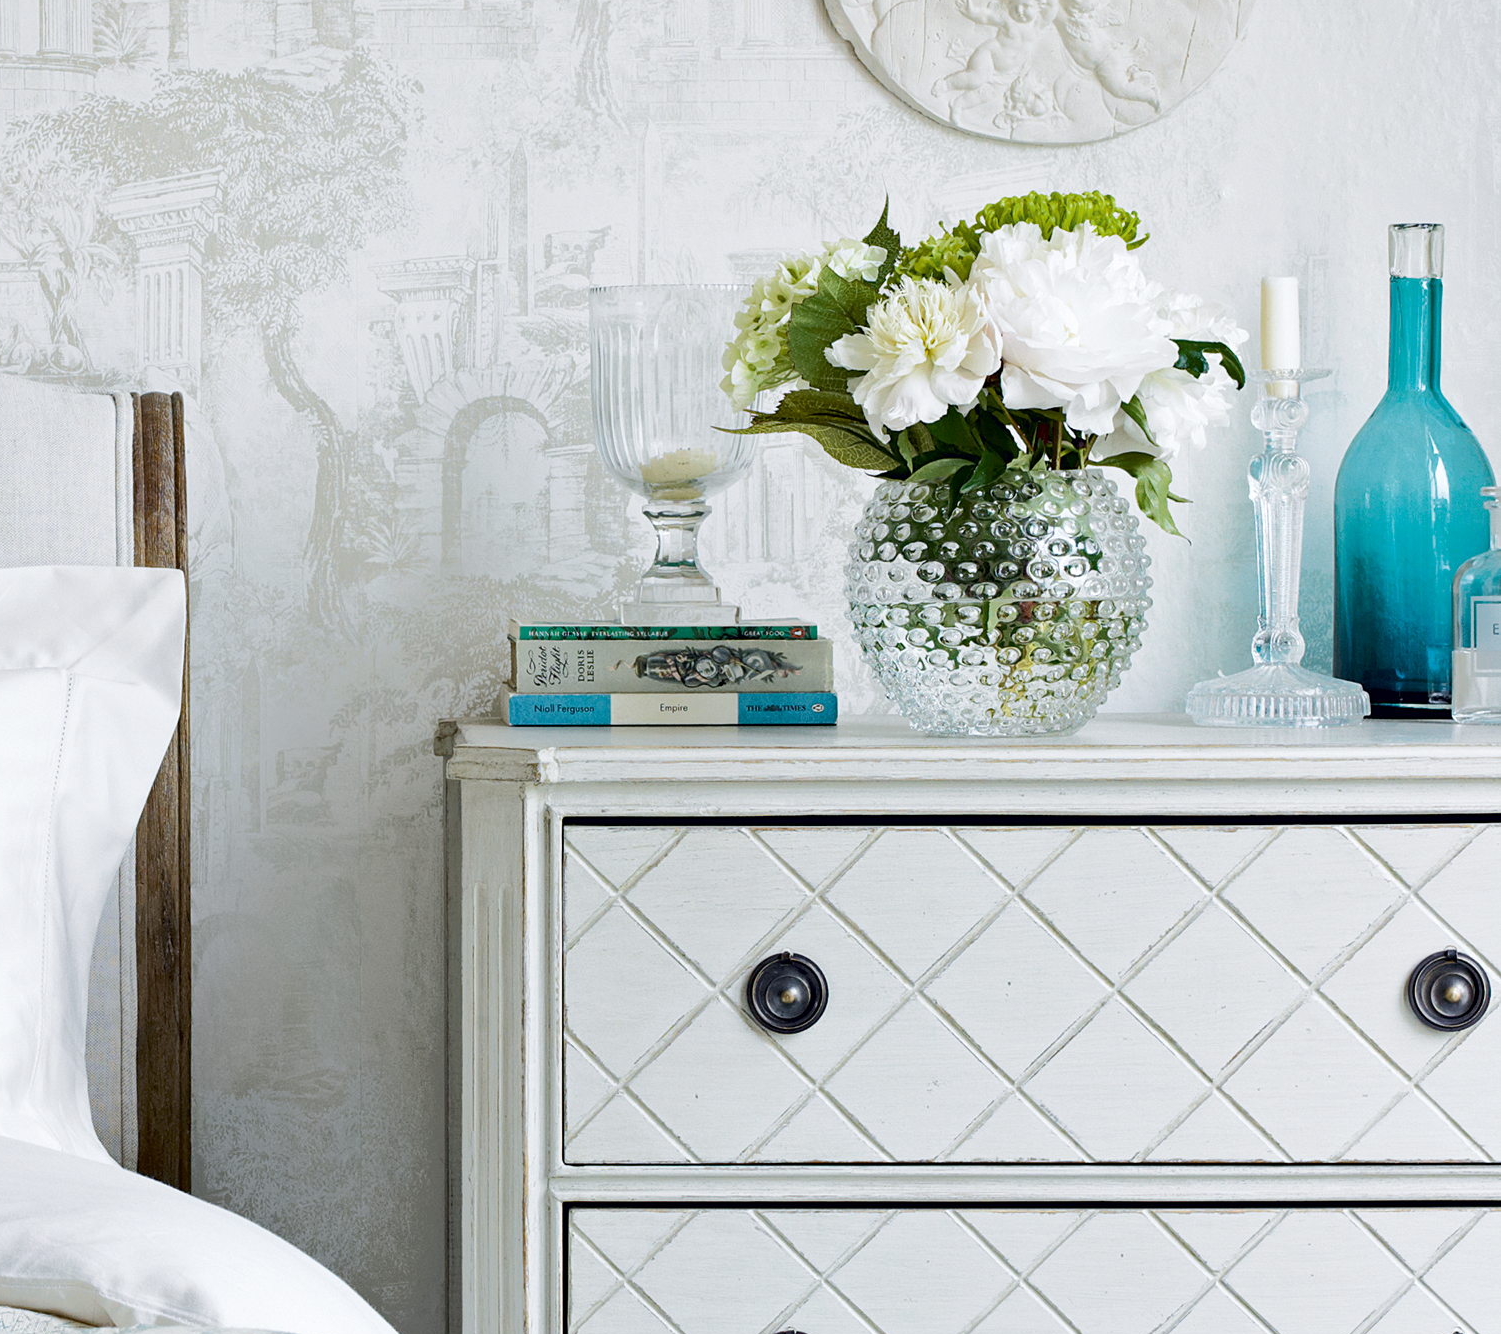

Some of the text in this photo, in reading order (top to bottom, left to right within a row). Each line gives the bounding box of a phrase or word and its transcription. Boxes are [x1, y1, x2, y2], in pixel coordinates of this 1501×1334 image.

[529, 645, 547, 687] Peridot
[548, 645, 568, 685] Flight
[534, 704, 595, 715] Niall Ferguson
[659, 703, 689, 713] Empire
